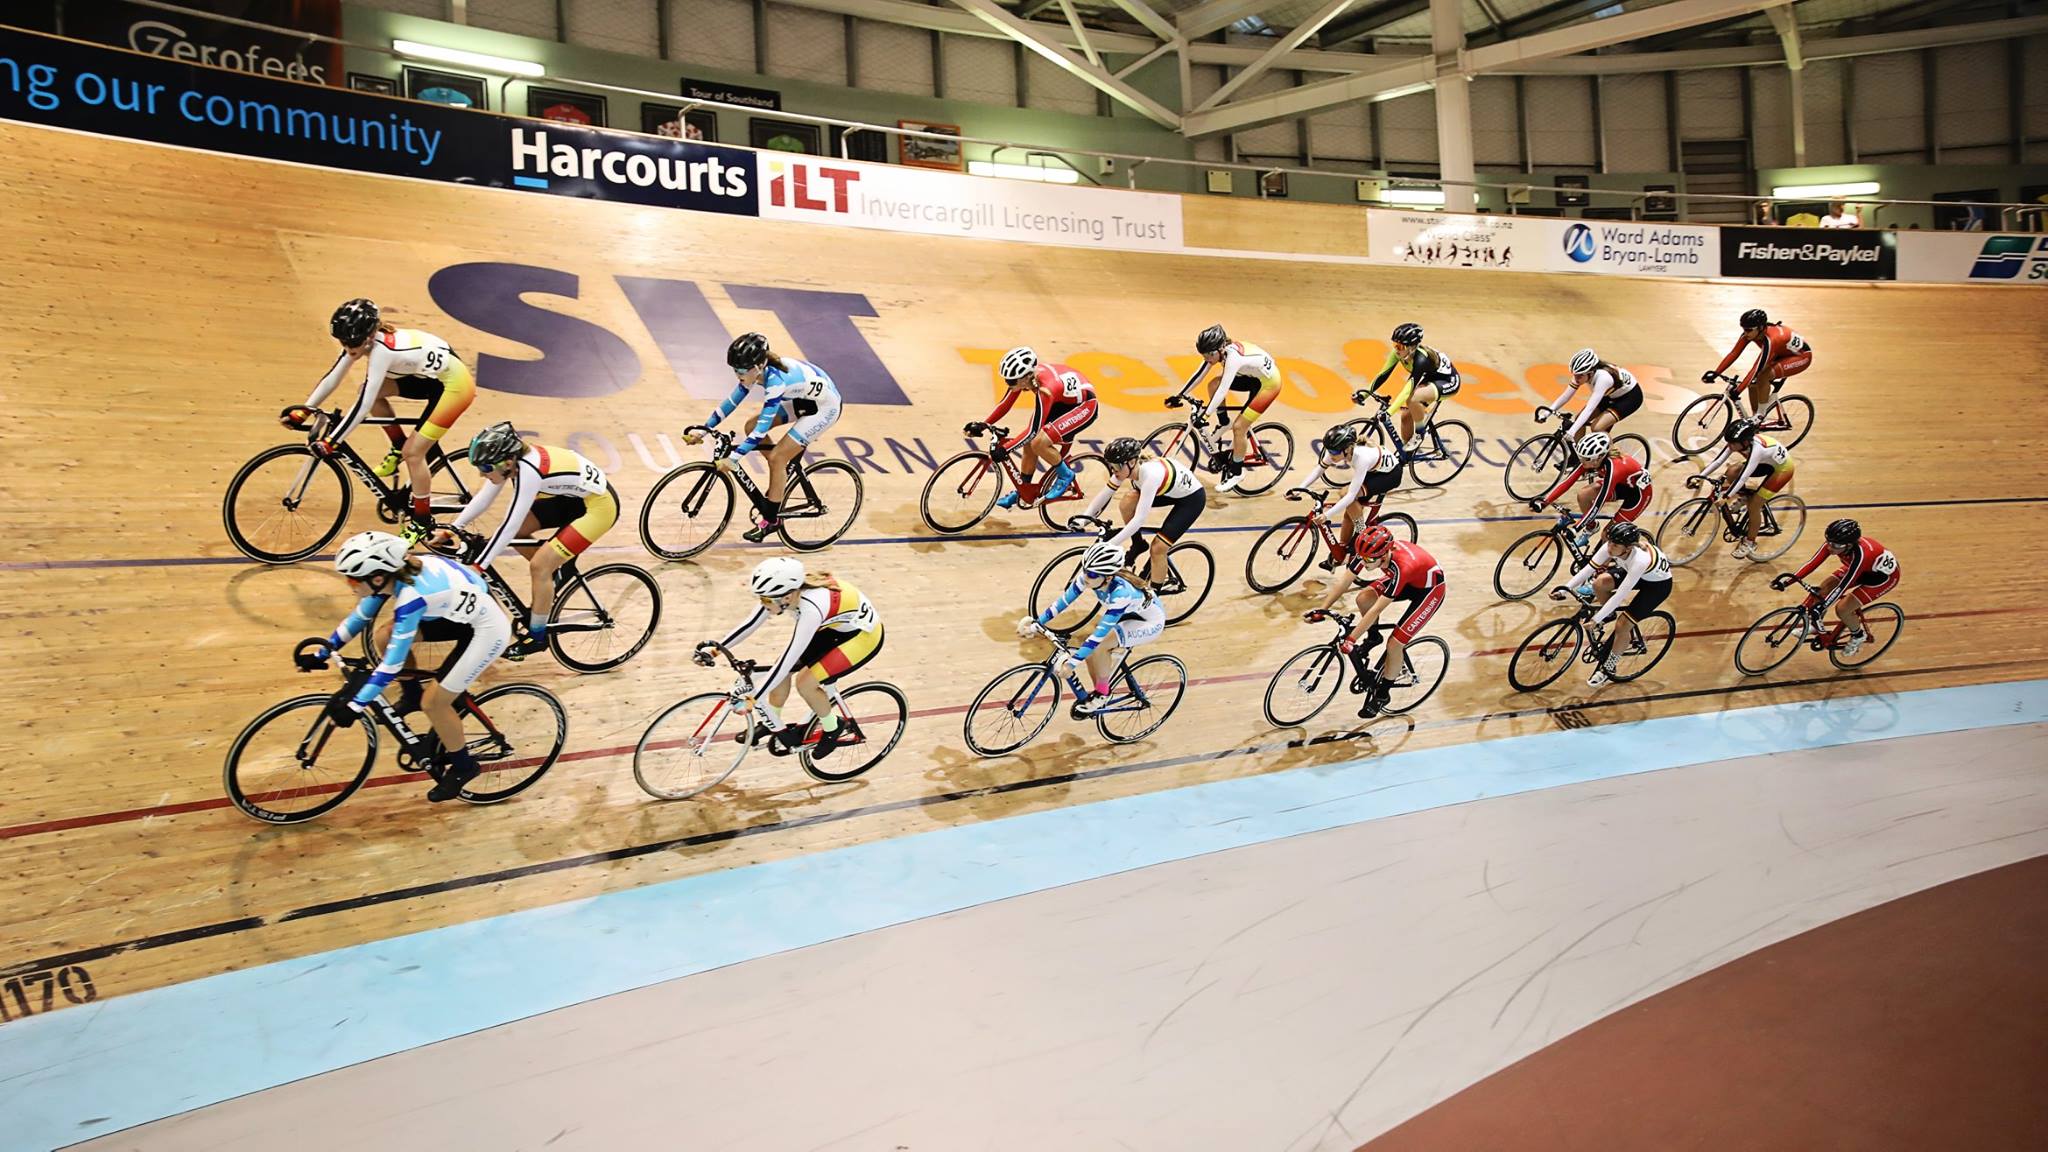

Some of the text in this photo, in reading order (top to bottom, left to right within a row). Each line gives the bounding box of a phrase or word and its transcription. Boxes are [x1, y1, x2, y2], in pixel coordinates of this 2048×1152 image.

[690, 88, 774, 108] Tour of Southland
[75, 73, 165, 114] our
[180, 91, 441, 165] community
[512, 128, 748, 198] Harcourts
[861, 193, 1166, 241] Invercargill Licensing Trust
[1602, 227, 1704, 247] Ward Adams
[1603, 245, 1699, 266] Bryan-Lamb
[1738, 242, 1881, 266] Fisher&Paykel
[1639, 265, 1667, 273] LAWYERS
[428, 262, 914, 405] SIT
[425, 351, 443, 371] 95
[1264, 356, 1272, 370] 93
[807, 381, 823, 397] 79
[1066, 377, 1077, 391] 82
[804, 407, 838, 440] AUCKLAND
[1058, 408, 1090, 430] CANTERBURY
[585, 465, 600, 484] 92
[454, 591, 477, 615] 78
[1407, 597, 1438, 633] CANTERBURY
[1127, 622, 1163, 640] AUCKLAND
[464, 639, 502, 684] AUCKLAND
